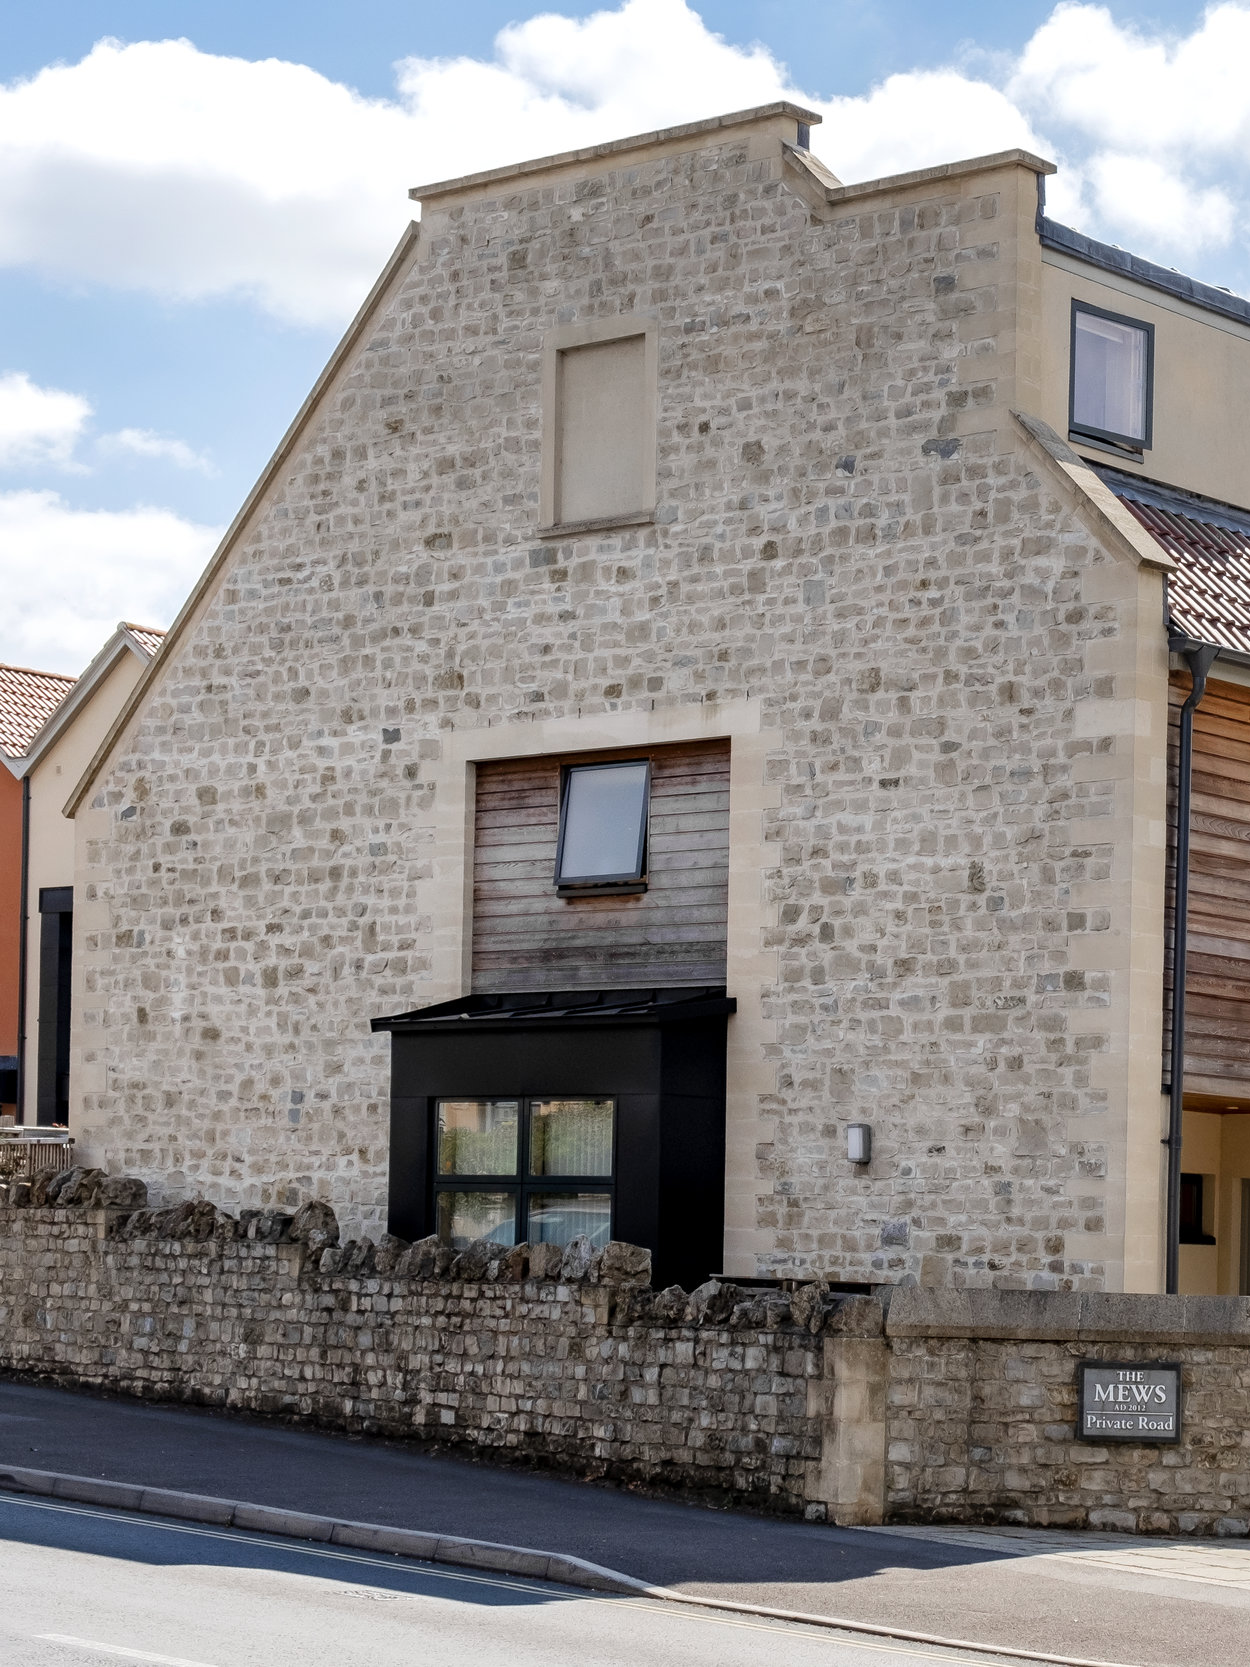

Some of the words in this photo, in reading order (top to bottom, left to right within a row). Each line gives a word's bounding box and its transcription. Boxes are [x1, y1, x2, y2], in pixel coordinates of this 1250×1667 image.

[1117, 1371, 1145, 1382] THE
[1094, 1383, 1167, 1404] MEWS
[1128, 1404, 1146, 1412] 2012
[1086, 1415, 1134, 1429] Private
[1138, 1416, 1174, 1431] Road
